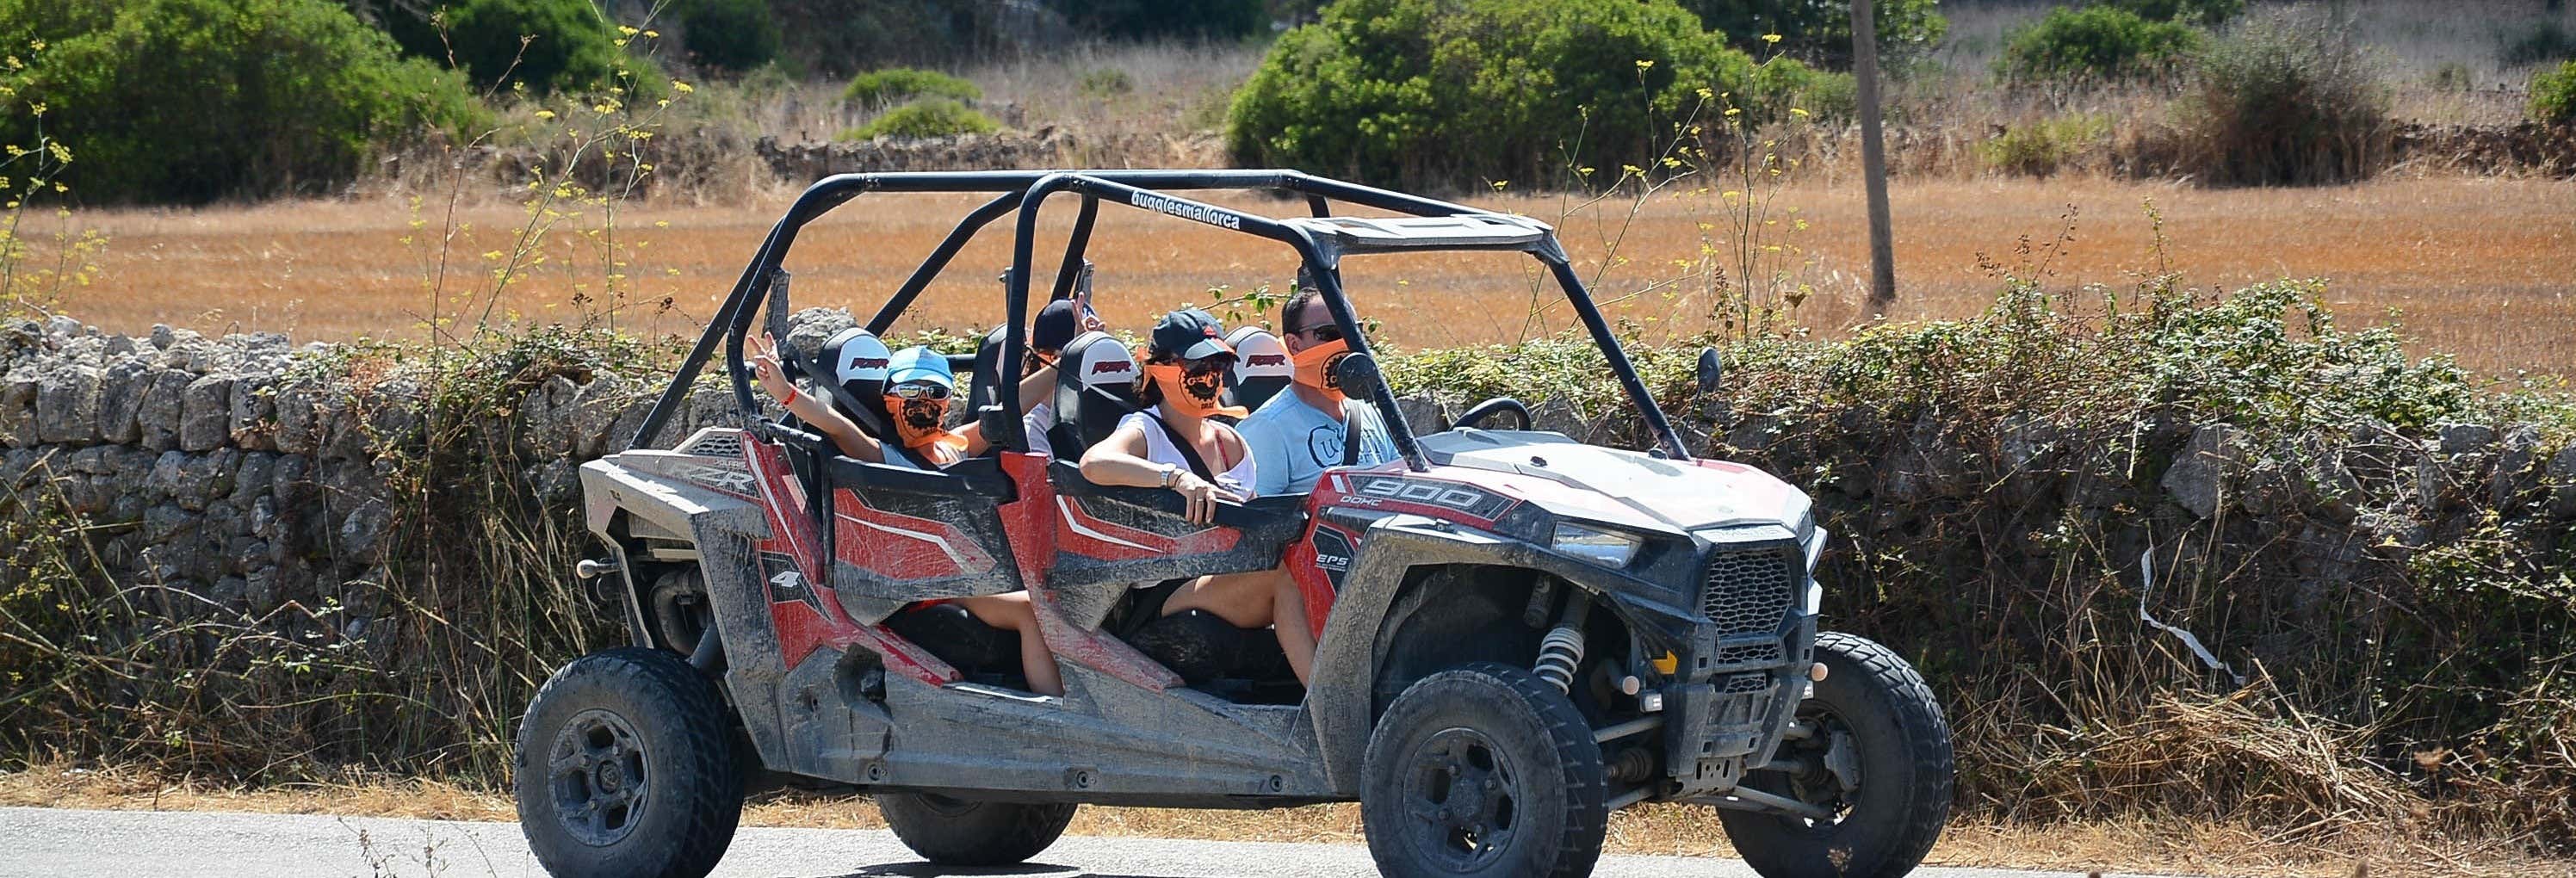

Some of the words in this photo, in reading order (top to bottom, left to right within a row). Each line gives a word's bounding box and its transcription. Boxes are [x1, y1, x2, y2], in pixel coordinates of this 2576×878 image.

[1340, 495, 1383, 507] DOHC
[1362, 479, 1483, 508] 900
[1316, 553, 1349, 566] EPS
[770, 571, 800, 588] 4
